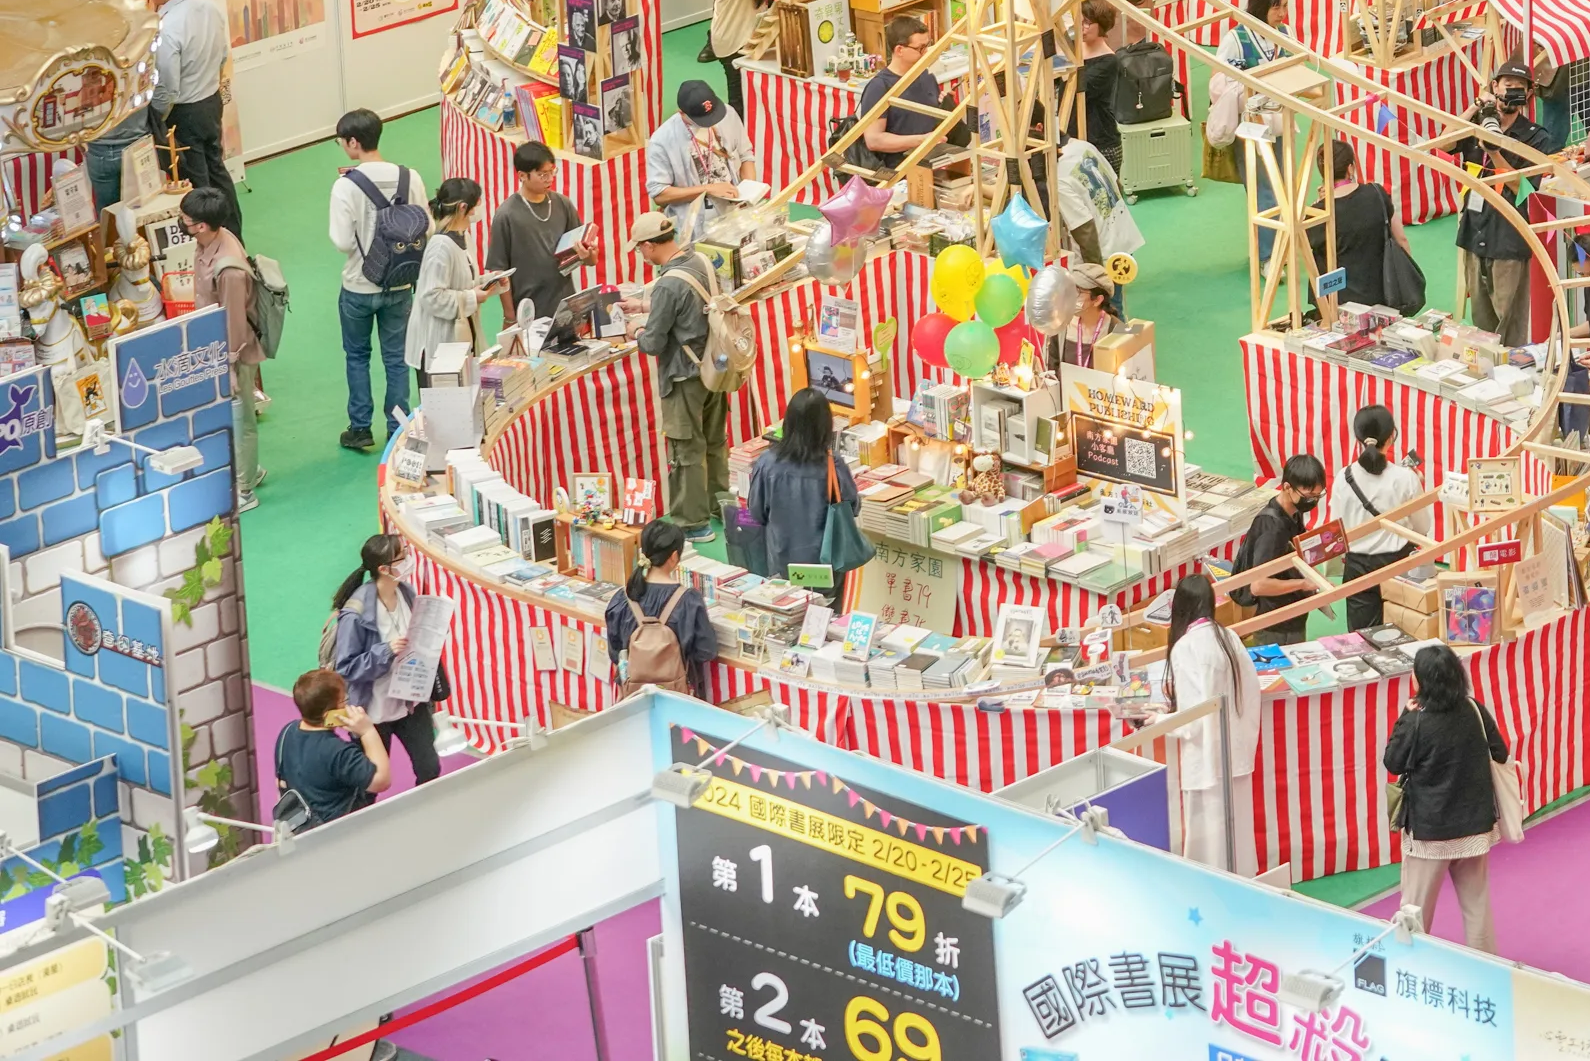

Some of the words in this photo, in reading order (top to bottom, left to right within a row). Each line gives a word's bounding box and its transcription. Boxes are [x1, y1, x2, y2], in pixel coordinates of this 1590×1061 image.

[356, 0, 375, 8] 2/20
[154, 339, 229, 380] 水滴文化
[159, 382, 173, 395] Les
[174, 373, 204, 390] Gouttes
[205, 365, 229, 381] Press
[1088, 388, 1155, 413] HOMEWARD
[1089, 401, 1155, 427] PUBLISHING
[1088, 451, 1119, 466] Podcast
[874, 541, 943, 579] 南方家園
[101, 629, 163, 665] 奇幻基地
[703, 784, 741, 812] 024
[749, 794, 866, 856] 國際書展限定
[848, 939, 961, 1002] (最低價那本)
[1356, 977, 1386, 995] FLAG
[1019, 949, 1206, 1040] 國際書展
[1395, 968, 1498, 1027] 旗標科技
[843, 995, 943, 1061] 69
